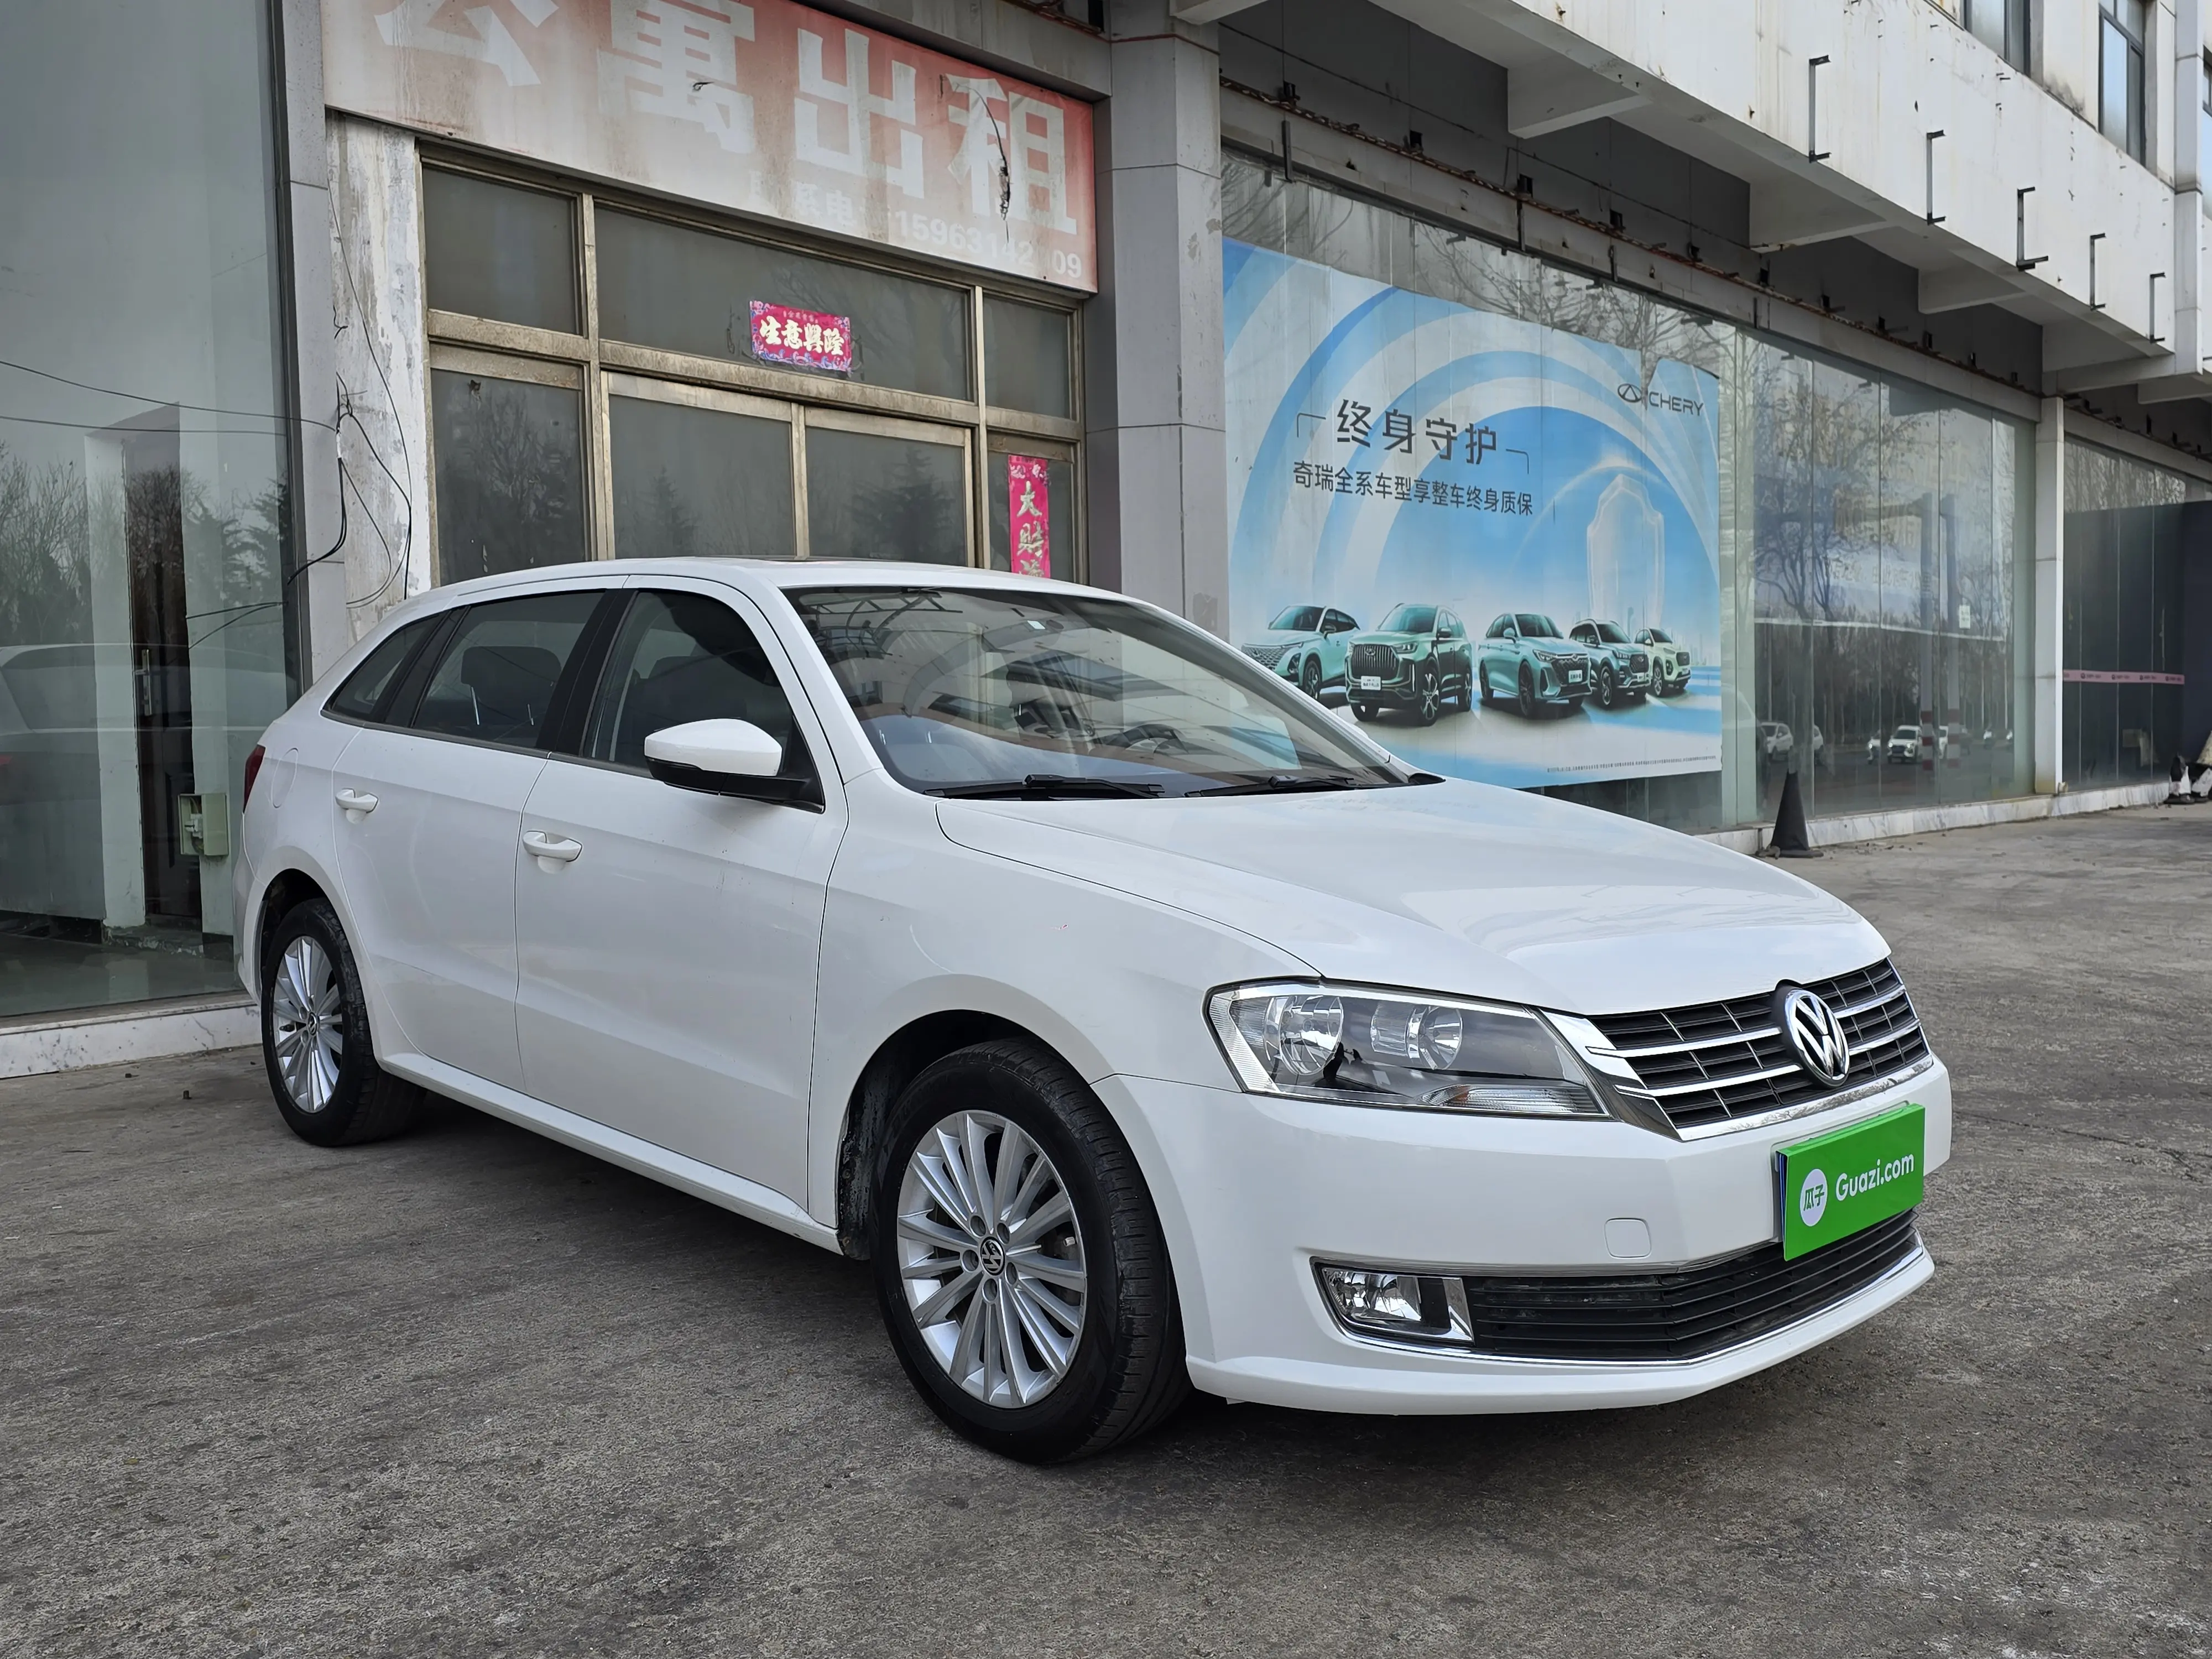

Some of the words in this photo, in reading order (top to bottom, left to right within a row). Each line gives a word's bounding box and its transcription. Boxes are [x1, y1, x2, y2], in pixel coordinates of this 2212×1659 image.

[1648, 390, 1704, 416] CHERY
[1337, 399, 1497, 465] 终身守护
[1293, 460, 1532, 516] 奇瑞全系车型享整车终身质保
[1803, 1184, 1825, 1212] 瓜子
[1835, 1153, 1915, 1202] Guazi.com
